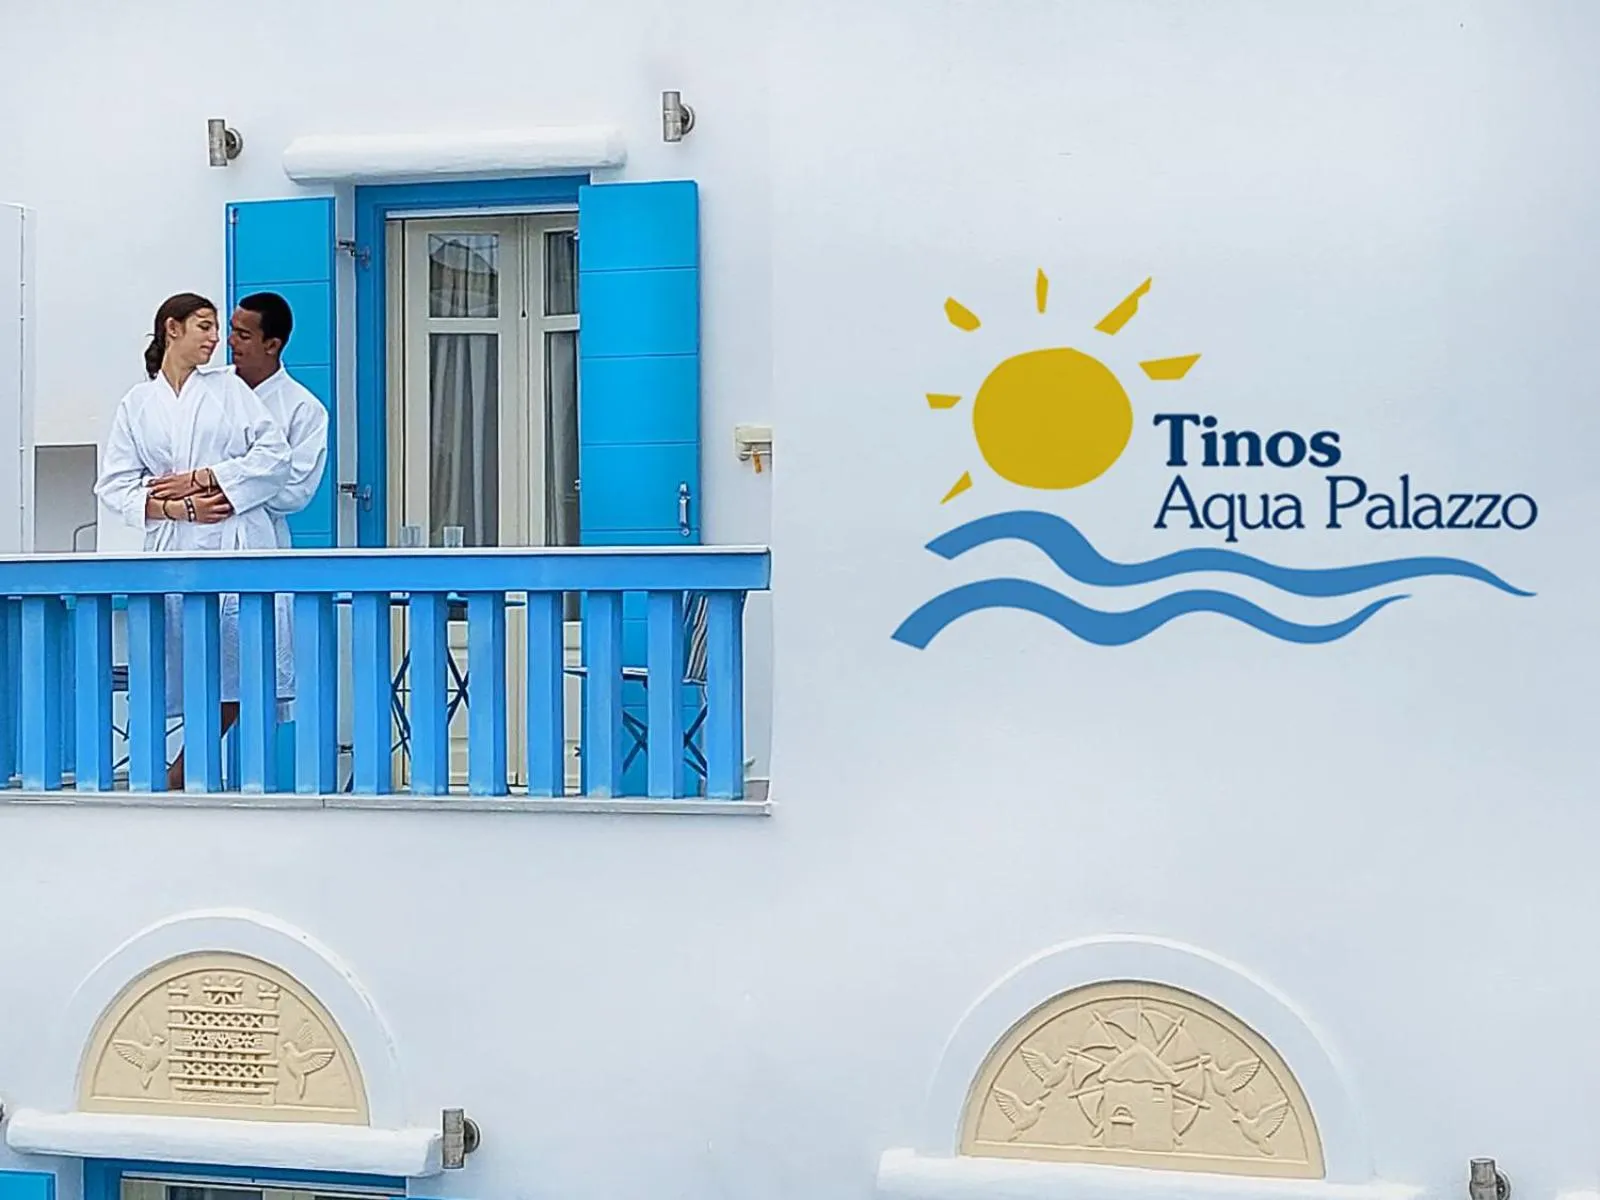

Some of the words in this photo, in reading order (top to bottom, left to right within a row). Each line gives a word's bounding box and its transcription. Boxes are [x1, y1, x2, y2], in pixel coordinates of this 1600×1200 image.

[1153, 413, 1342, 468] Tinos
[1153, 474, 1305, 543] Aqua
[1325, 473, 1538, 530] Palazzo
